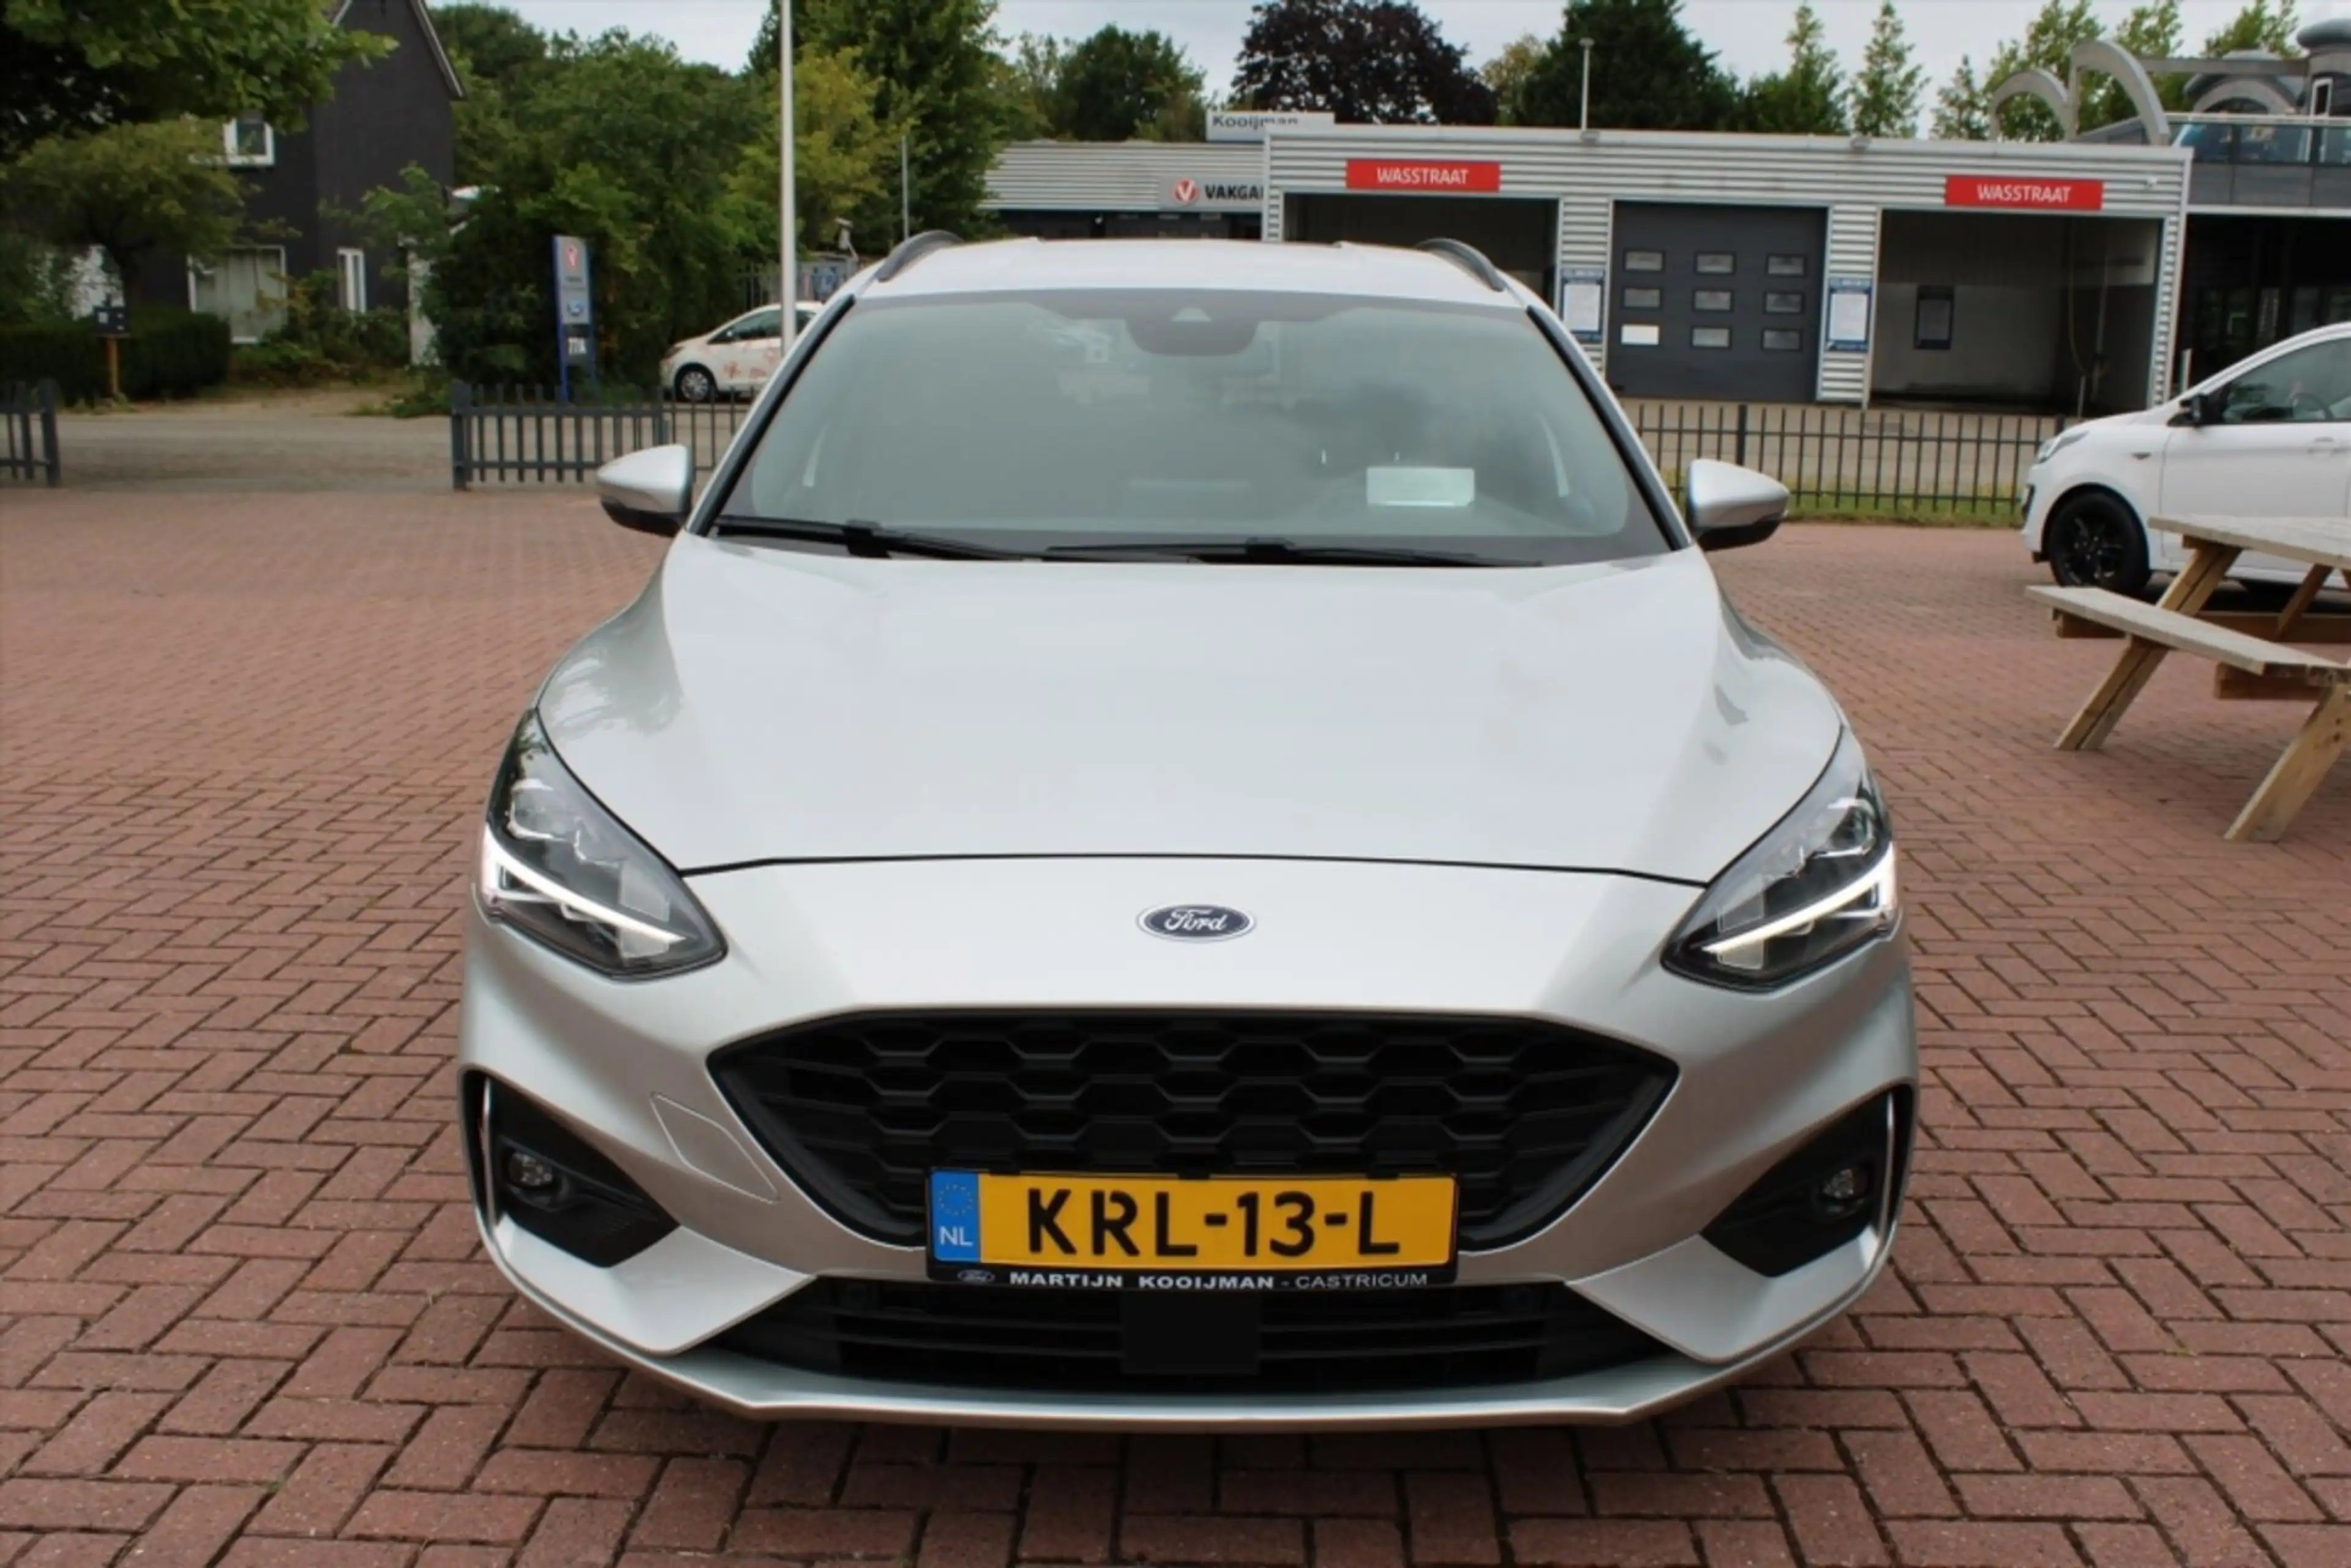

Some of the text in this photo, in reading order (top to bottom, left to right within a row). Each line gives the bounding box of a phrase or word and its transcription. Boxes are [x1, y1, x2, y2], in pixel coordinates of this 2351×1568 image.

[1376, 167, 1469, 184] WASSTRAAT
[1976, 184, 2071, 203] WASSTRAAT
[1163, 908, 1229, 931] Ford
[1027, 1188, 1400, 1257] KRL-13-L
[939, 1226, 973, 1247] NL
[1009, 1271, 1122, 1287] MARTIJN
[1139, 1275, 1273, 1290] KOOIJMAN
[1295, 1274, 1428, 1289] CASTRICUM
